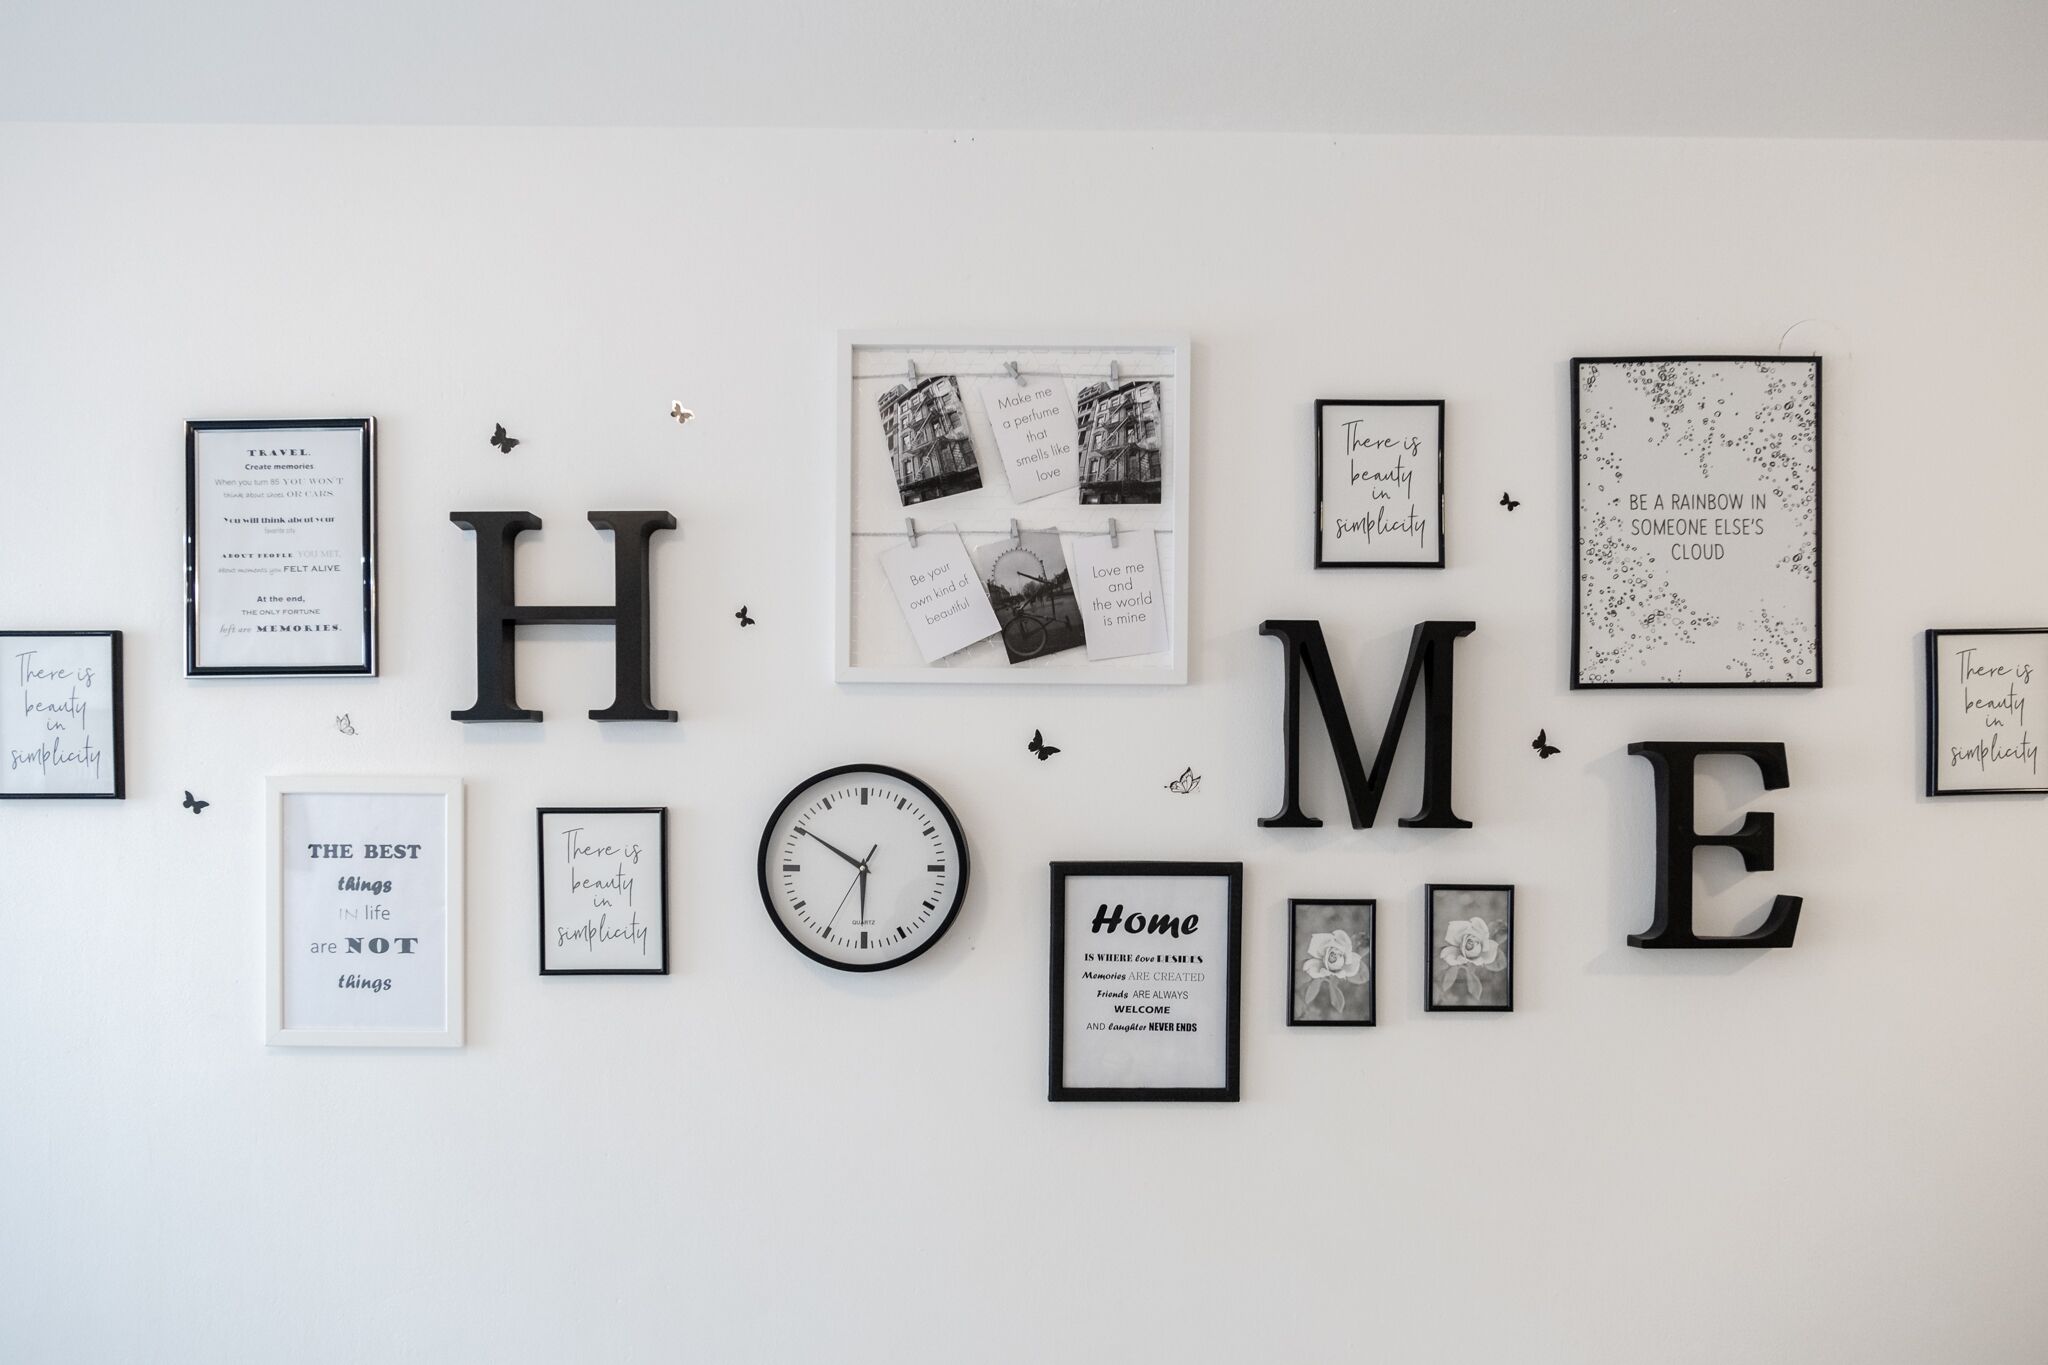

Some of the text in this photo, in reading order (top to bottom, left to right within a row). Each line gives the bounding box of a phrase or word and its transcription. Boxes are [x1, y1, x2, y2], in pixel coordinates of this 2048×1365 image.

[998, 388, 1052, 410] Make me
[1002, 406, 1060, 430] a perfume
[1026, 429, 1048, 442] that
[1342, 420, 1422, 456] There is
[247, 449, 311, 457] TRAVEL.
[1016, 443, 1070, 467] smells like
[238, 480, 252, 488] you
[282, 478, 303, 486] YOU
[1036, 468, 1061, 482] love
[1351, 454, 1412, 500] beauty
[1372, 486, 1391, 500] in
[1630, 494, 1766, 510] BE A RAINBOW IN
[1336, 504, 1426, 548] simplicity
[1631, 518, 1764, 536] SOMEONE ELSE'S
[1671, 544, 1724, 560] CLOUD
[910, 564, 950, 586] Be your
[1093, 564, 1144, 578] Love me
[910, 574, 968, 610] own kind of
[1108, 577, 1133, 592] and
[925, 596, 970, 624] beautiful
[1093, 591, 1152, 611] the world
[449, 510, 678, 723] H
[1104, 612, 1146, 626] is mine
[220, 624, 236, 636] left
[256, 624, 342, 632] MEMORIES.
[16, 650, 95, 688] There is
[1955, 648, 2034, 684] There is
[24, 686, 86, 730] beauty
[1964, 682, 2024, 726] beauty
[46, 718, 66, 730] in
[1258, 620, 1476, 828] M
[1985, 714, 2004, 728] in
[12, 735, 102, 780] simplicity
[1951, 731, 2038, 775] simplicity
[308, 844, 422, 859] THE BEST
[562, 828, 642, 864] There is
[1628, 741, 1804, 948] E
[338, 876, 392, 896] things
[572, 862, 634, 907] beauty
[593, 895, 612, 908] in
[339, 905, 391, 920] IN life
[1092, 904, 1199, 938] Home
[558, 912, 648, 956] simplicity
[310, 937, 418, 954] are NOT
[1084, 953, 1094, 962] IS
[1097, 954, 1133, 962] WHERE
[1135, 954, 1154, 962] love
[338, 975, 392, 992] things
[1082, 972, 1204, 982] Memories ARE CREATED
[1096, 990, 1189, 999] Friends ARE ALWAYS
[1114, 1005, 1170, 1014] WELCOME
[1086, 1022, 1198, 1032] AND laughter NEVER ENDS
